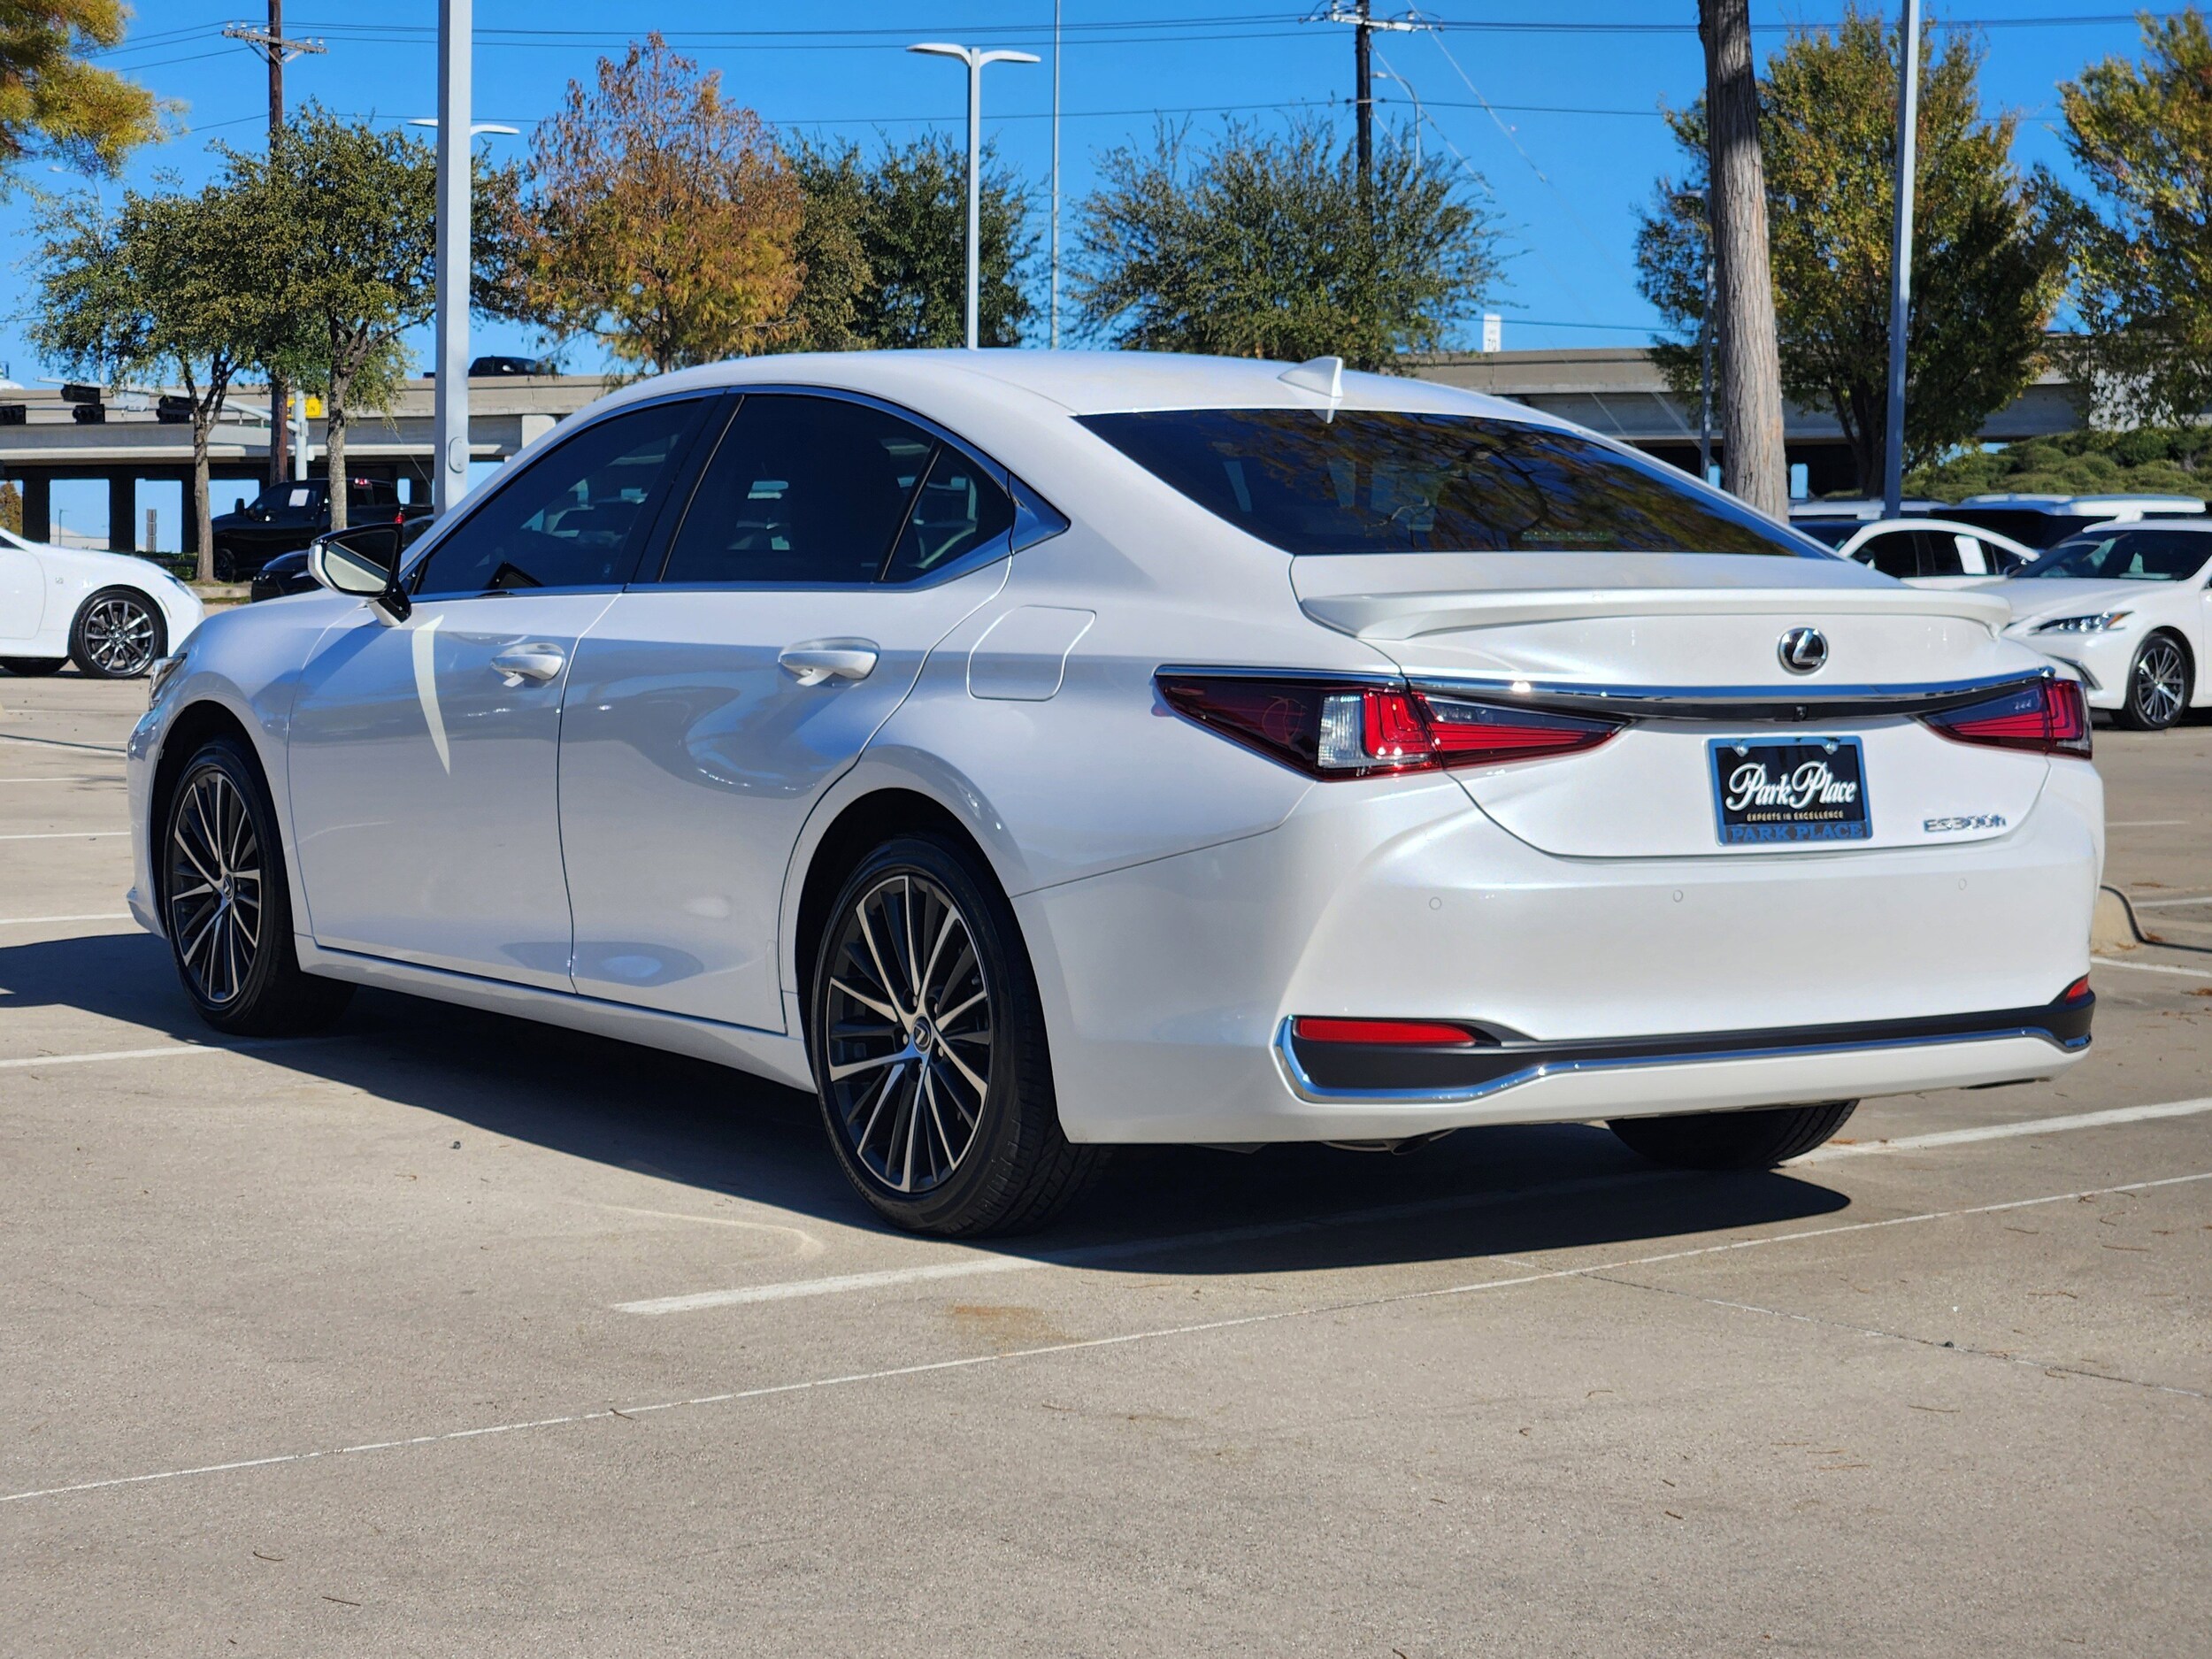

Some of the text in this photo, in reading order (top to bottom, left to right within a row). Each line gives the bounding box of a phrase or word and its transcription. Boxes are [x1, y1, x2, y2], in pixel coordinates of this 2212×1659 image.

[1725, 761, 1857, 811] Park Place
[1747, 811, 1781, 822] EXPERTS
[1793, 810, 1844, 821] EXCELLENCE
[1732, 822, 1863, 841] PARK PLACE
